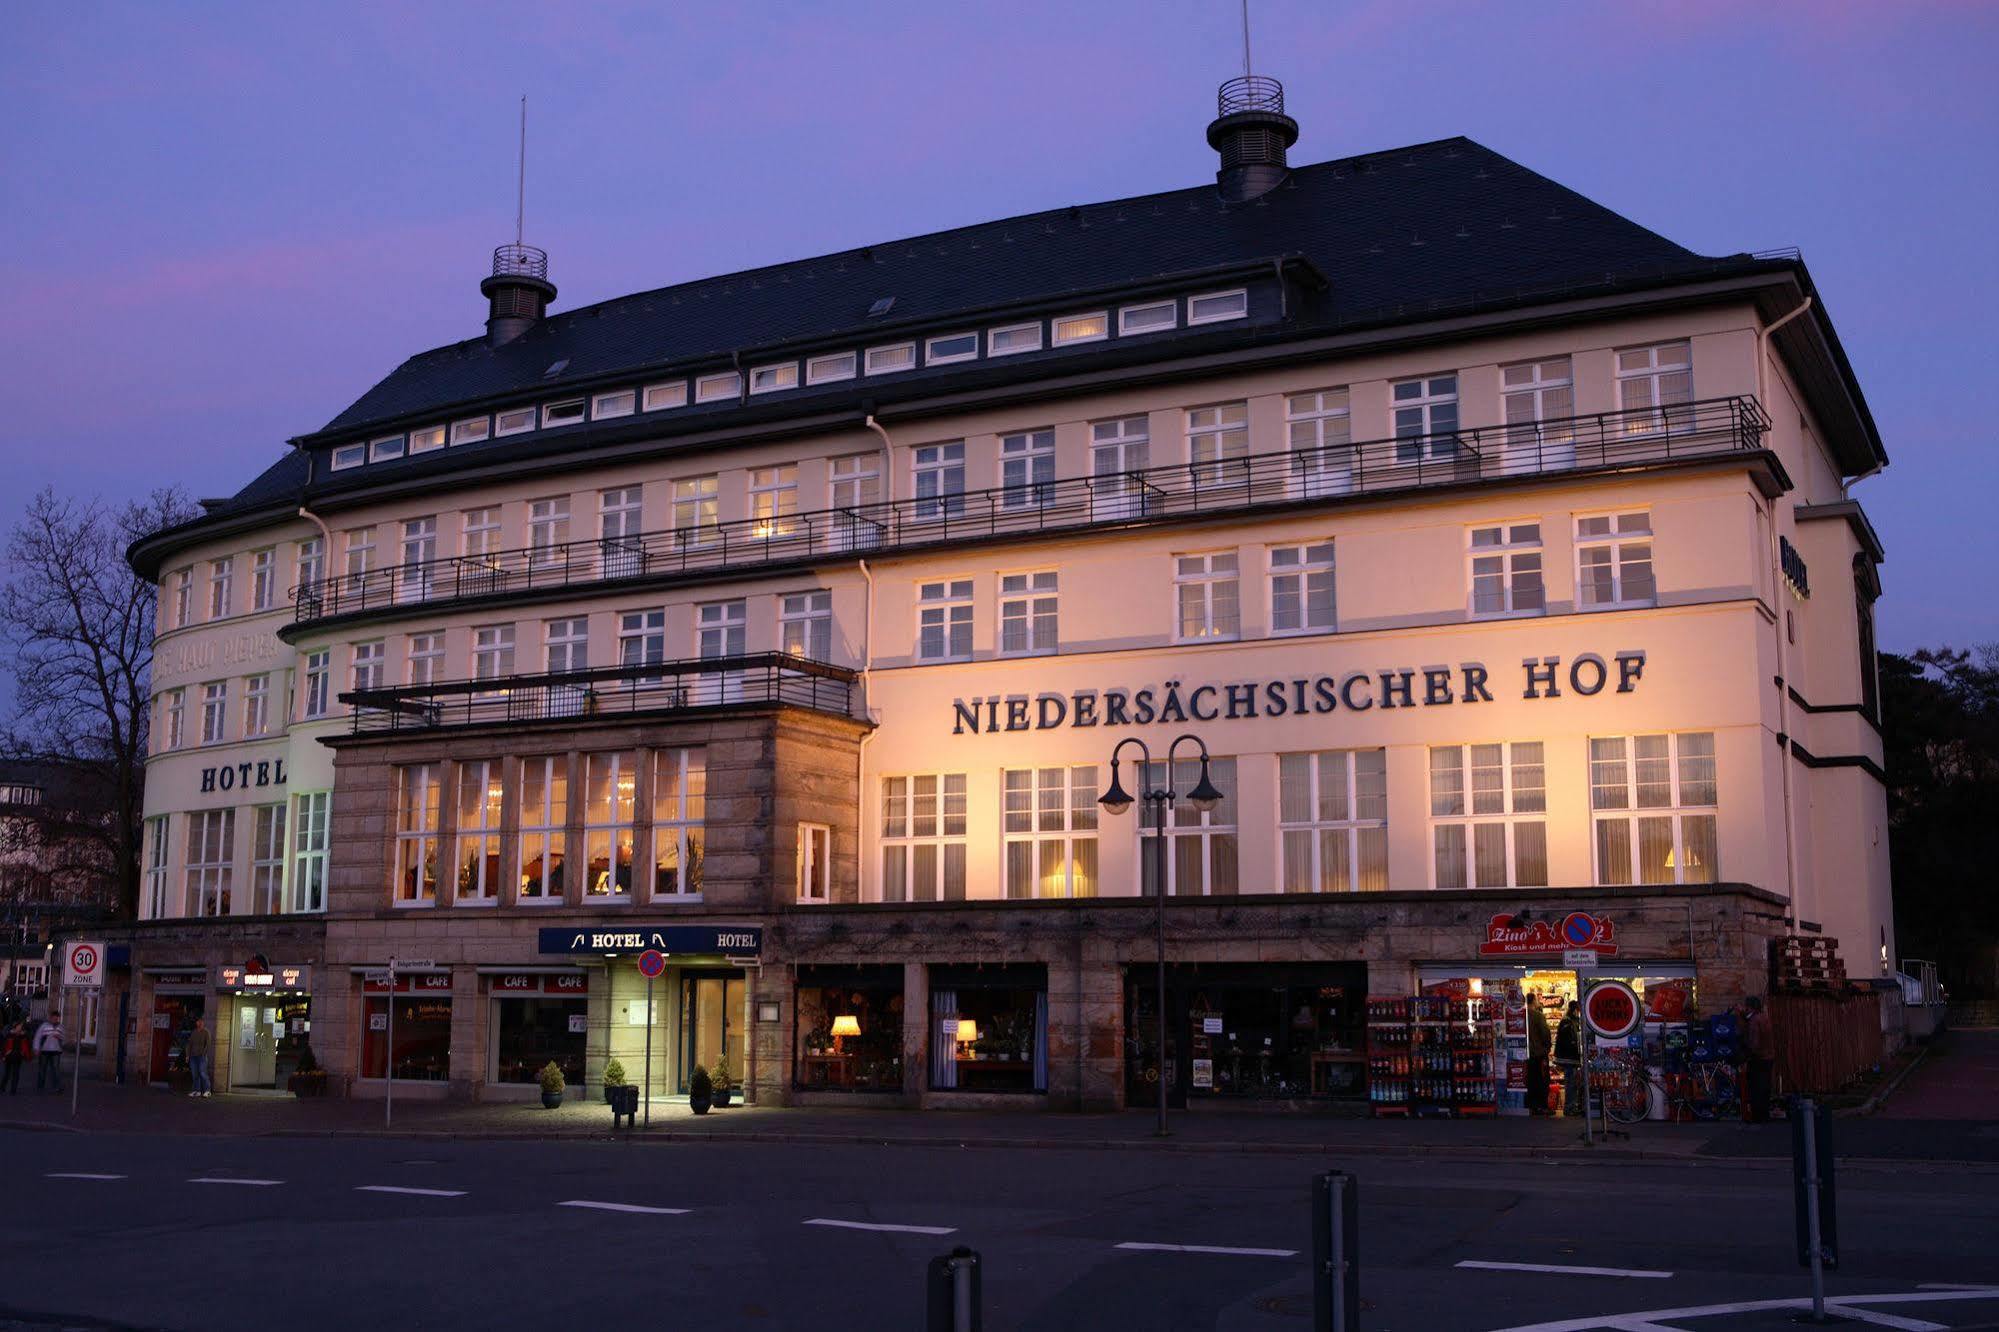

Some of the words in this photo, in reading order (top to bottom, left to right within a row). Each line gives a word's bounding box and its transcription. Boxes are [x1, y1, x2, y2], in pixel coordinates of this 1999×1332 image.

[951, 664, 1494, 735] NIEDERSÄCHSISCHER
[1523, 655, 1647, 700] HOF
[200, 759, 287, 793] HOTEL
[591, 933, 645, 948] HOTEL
[717, 933, 757, 948] HOTEL
[1529, 942, 1546, 951] und
[76, 952, 93, 967] 30
[72, 975, 93, 984] ZONE
